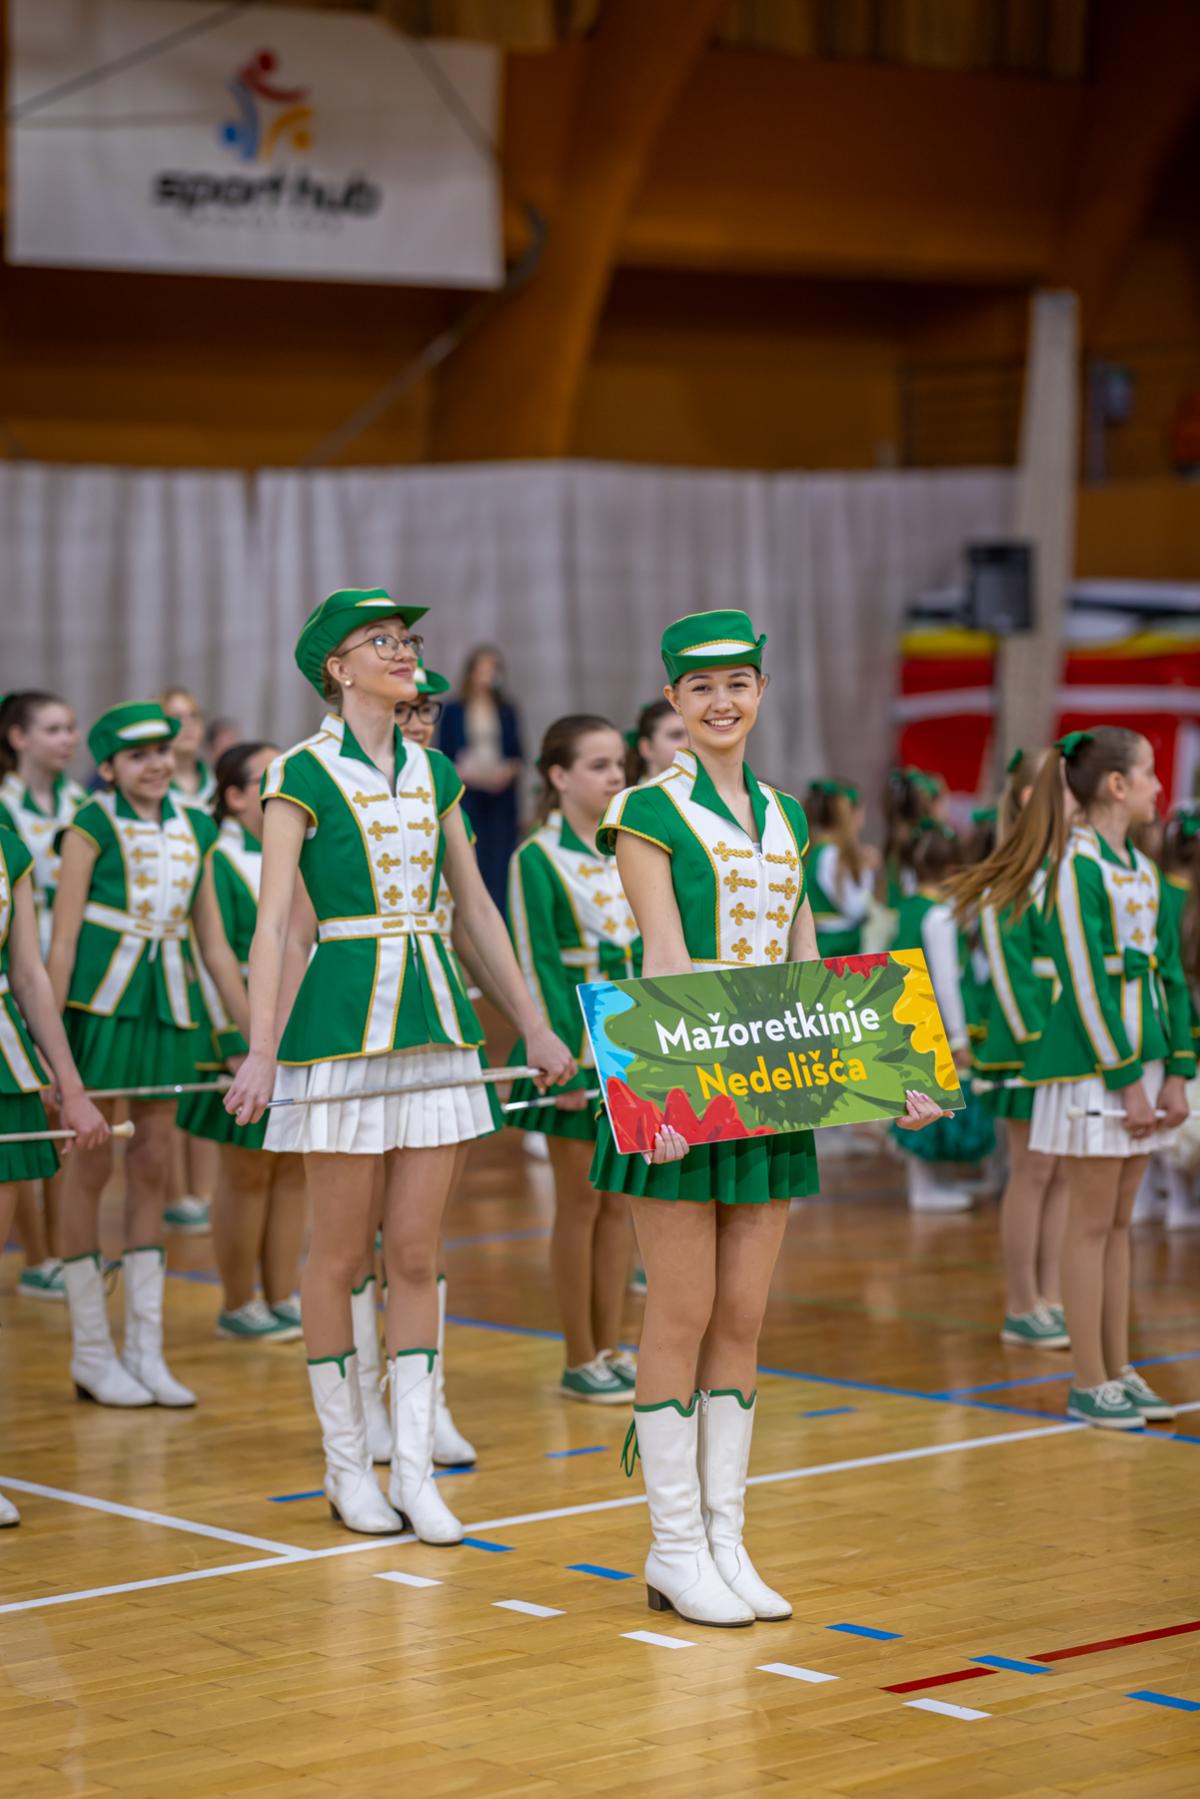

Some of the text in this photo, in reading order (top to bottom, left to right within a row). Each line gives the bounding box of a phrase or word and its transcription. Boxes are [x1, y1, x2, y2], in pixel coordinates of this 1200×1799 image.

[154, 169, 382, 218] sport hub
[654, 999, 880, 1055] Mažoretkinje
[695, 1048, 868, 1100] Nedelišća
